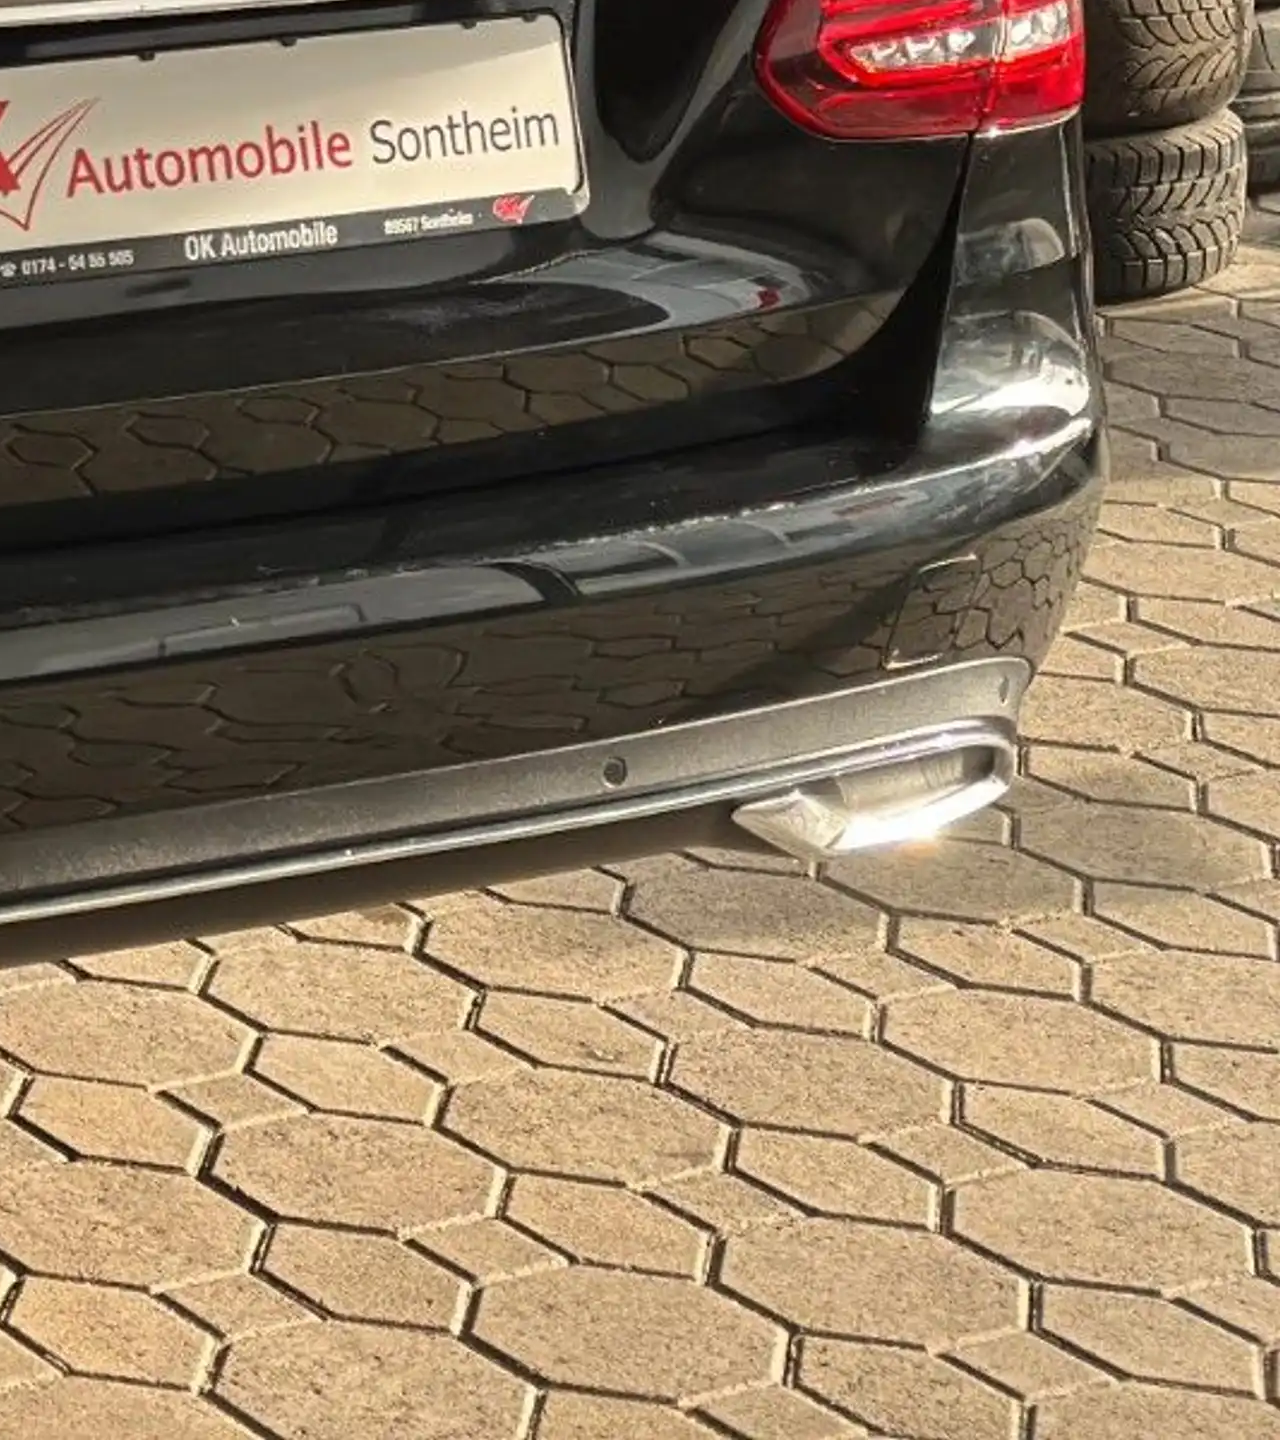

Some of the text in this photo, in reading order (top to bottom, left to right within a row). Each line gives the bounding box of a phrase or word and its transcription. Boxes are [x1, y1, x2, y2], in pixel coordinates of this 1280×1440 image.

[66, 106, 560, 198] Automobile Sontheim
[184, 220, 338, 261] OK Automobile
